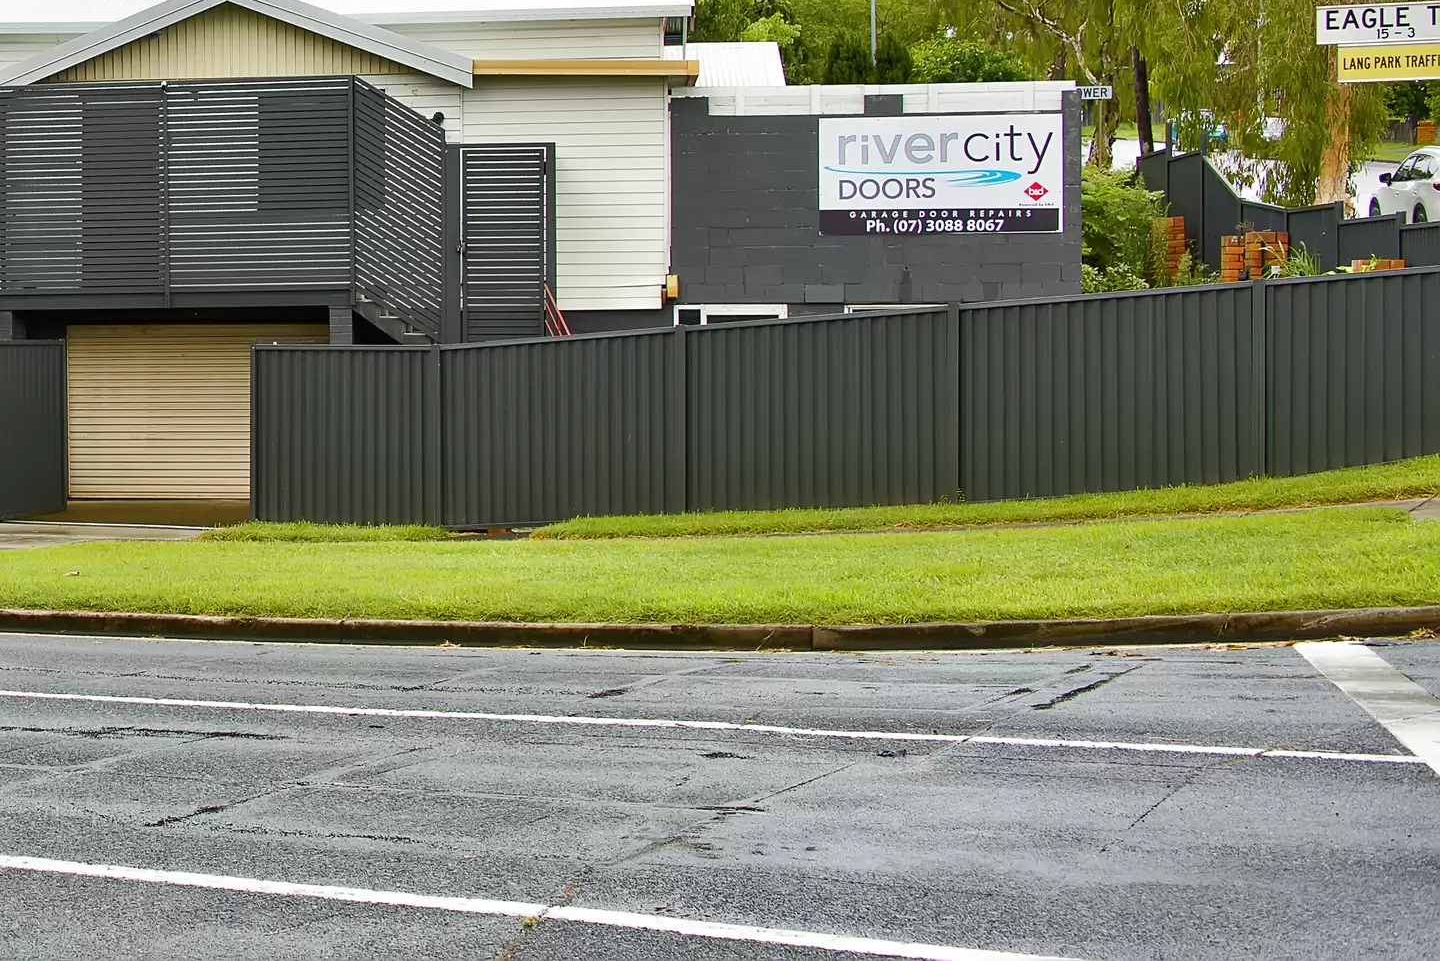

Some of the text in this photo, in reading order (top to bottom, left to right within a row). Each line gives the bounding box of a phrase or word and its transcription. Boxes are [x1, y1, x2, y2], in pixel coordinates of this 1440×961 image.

[1326, 7, 1410, 30] EAGLE
[1377, 29, 1389, 39] 15
[1408, 27, 1415, 38] 3
[1344, 58, 1371, 70] LANG
[1374, 56, 1401, 69] PARK
[839, 178, 936, 200] DOORS
[849, 210, 1032, 219] GARAGE DOOR REPAIRS
[866, 218, 1005, 234] Ph. (07) 3088 8067
